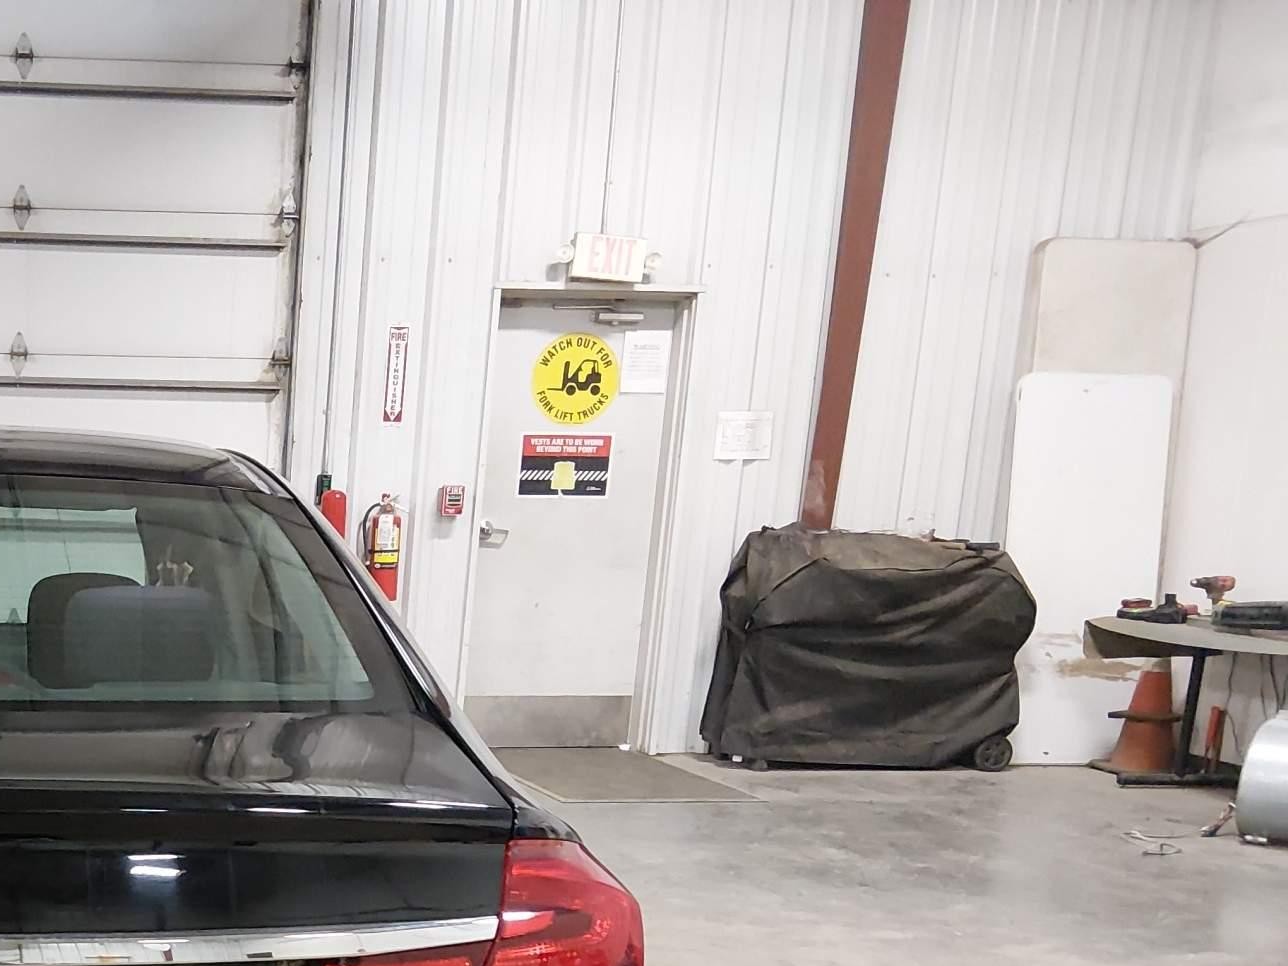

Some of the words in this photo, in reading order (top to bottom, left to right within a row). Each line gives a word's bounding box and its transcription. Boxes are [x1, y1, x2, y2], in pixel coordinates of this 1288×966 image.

[588, 235, 637, 276] EXIT
[391, 332, 407, 341] FIRE
[539, 338, 573, 367] WATCH
[576, 337, 597, 349] OUT
[596, 347, 613, 369] FOR
[389, 342, 401, 416] EXTINGUISHER
[537, 390, 555, 414] FORK
[554, 409, 574, 421] LIFT
[577, 393, 609, 420] TRUCKS
